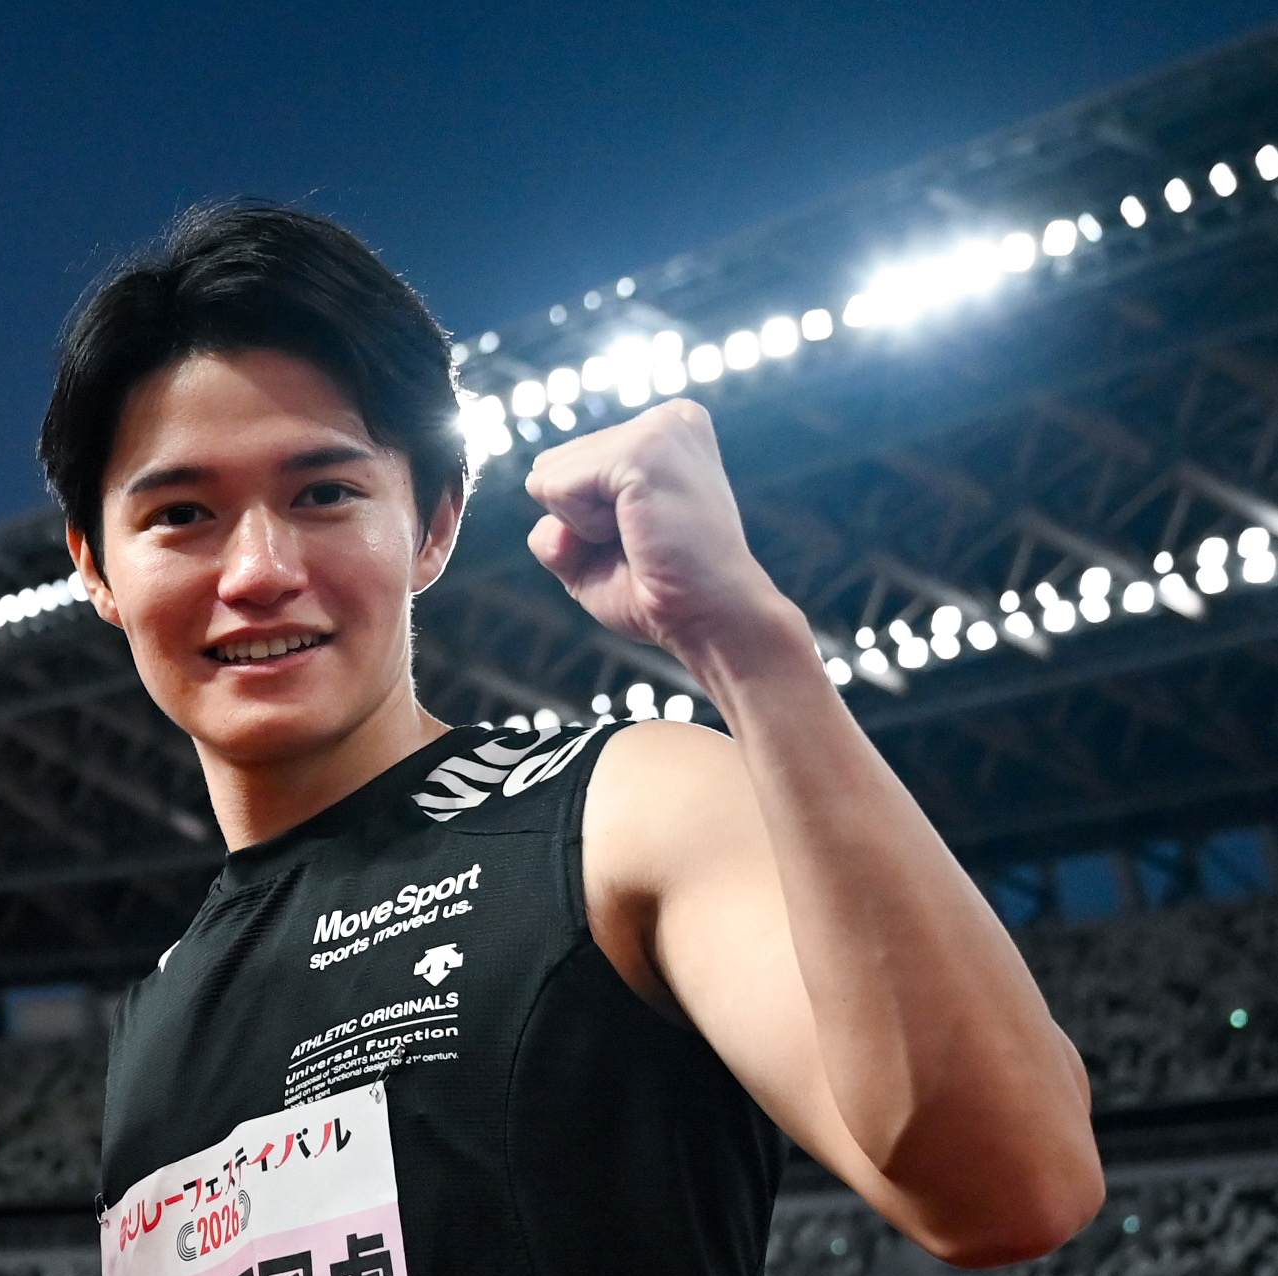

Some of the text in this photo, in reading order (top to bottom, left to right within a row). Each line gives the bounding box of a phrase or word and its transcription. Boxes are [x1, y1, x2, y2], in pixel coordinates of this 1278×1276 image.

[309, 899, 473, 971] sports moved us.
[285, 1026, 459, 1086] Universal Function
[290, 992, 459, 1060] ATHLETIC ORIGINALS
[327, 1067, 362, 1085] functional
[128, 1117, 352, 1241] リレーフェスティバル
[197, 1198, 240, 1257] 2026
